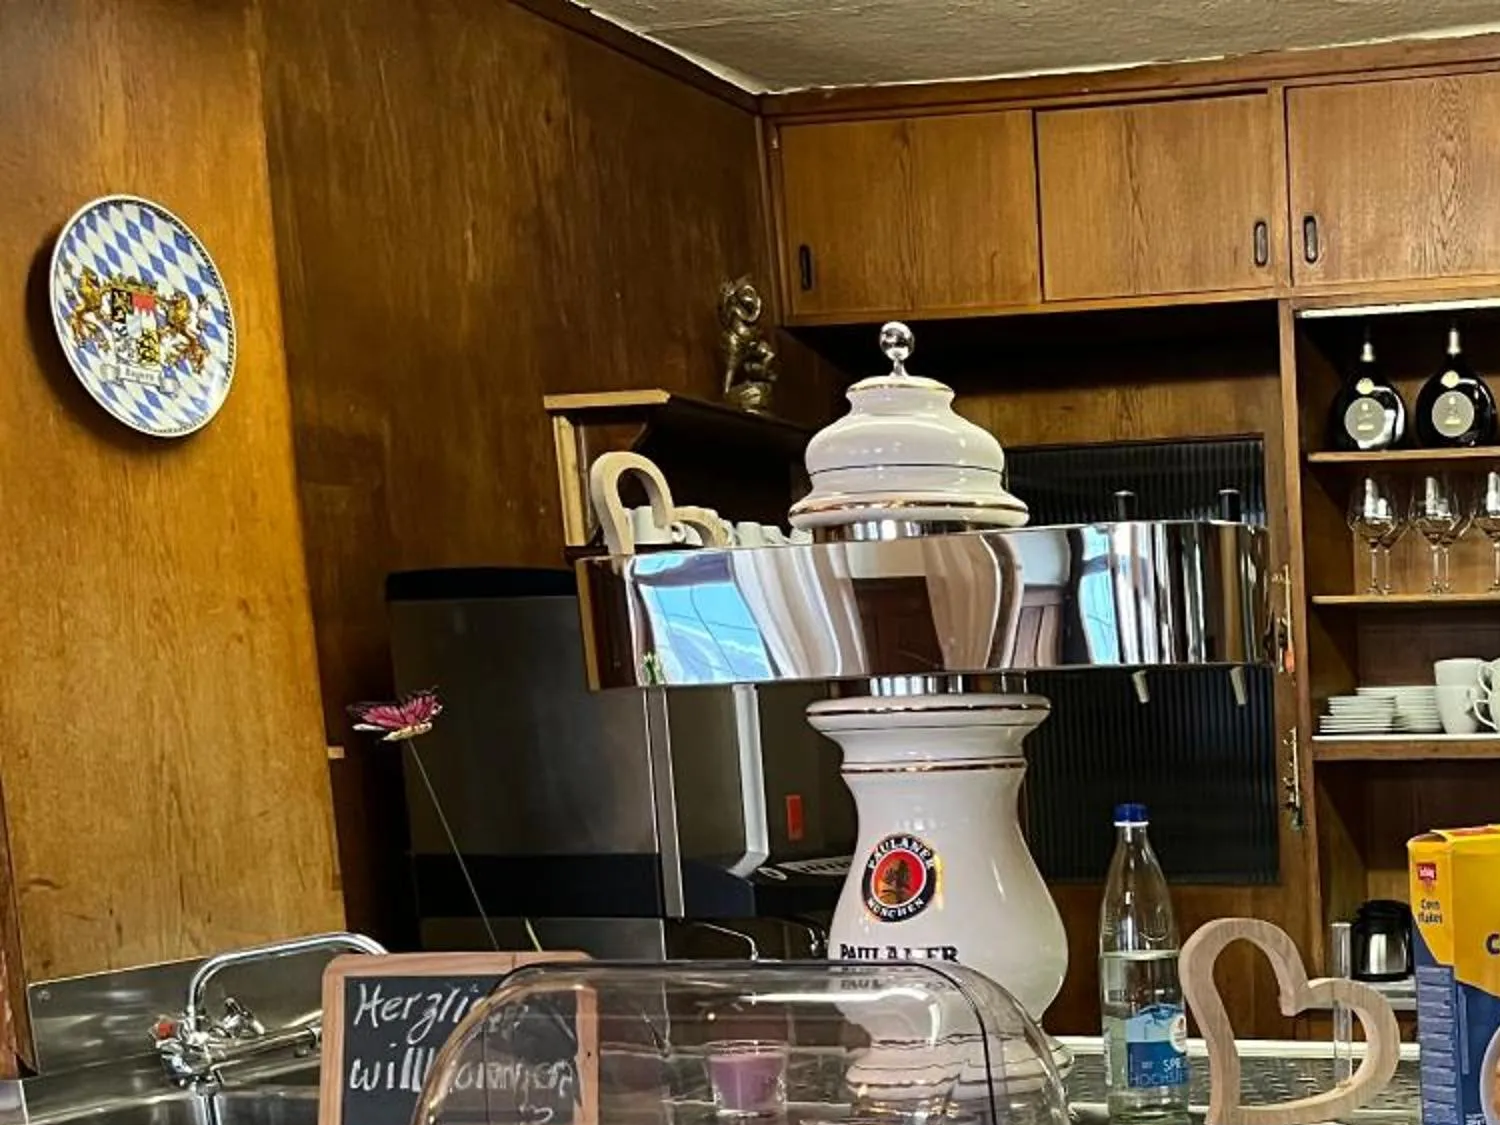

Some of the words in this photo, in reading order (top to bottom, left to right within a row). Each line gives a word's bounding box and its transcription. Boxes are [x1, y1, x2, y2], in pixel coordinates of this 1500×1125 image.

[867, 837, 935, 870] PAULANER
[353, 982, 529, 1045] Herzli
[349, 1042, 574, 1099] willommen
